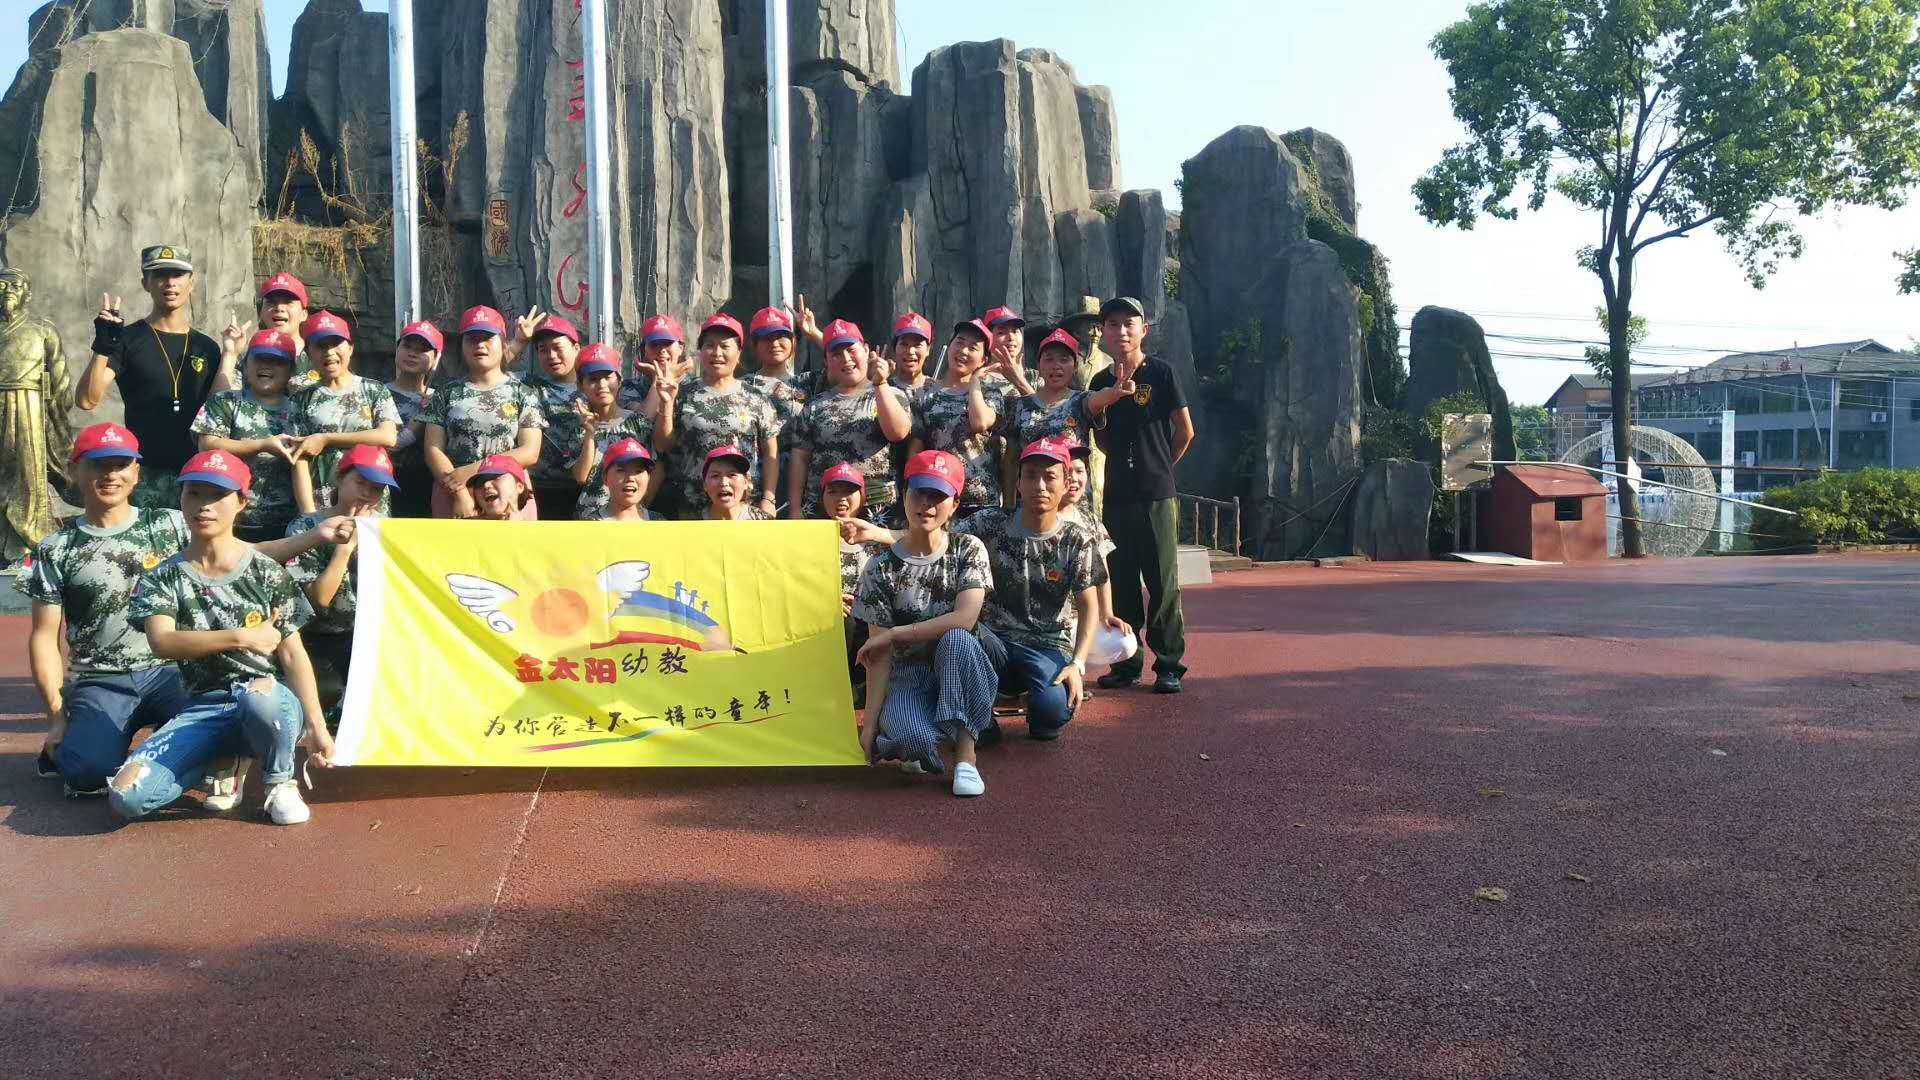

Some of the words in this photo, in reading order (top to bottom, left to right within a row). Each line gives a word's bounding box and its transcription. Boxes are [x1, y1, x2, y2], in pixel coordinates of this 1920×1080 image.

[514, 647, 689, 684] 金太阳幼教
